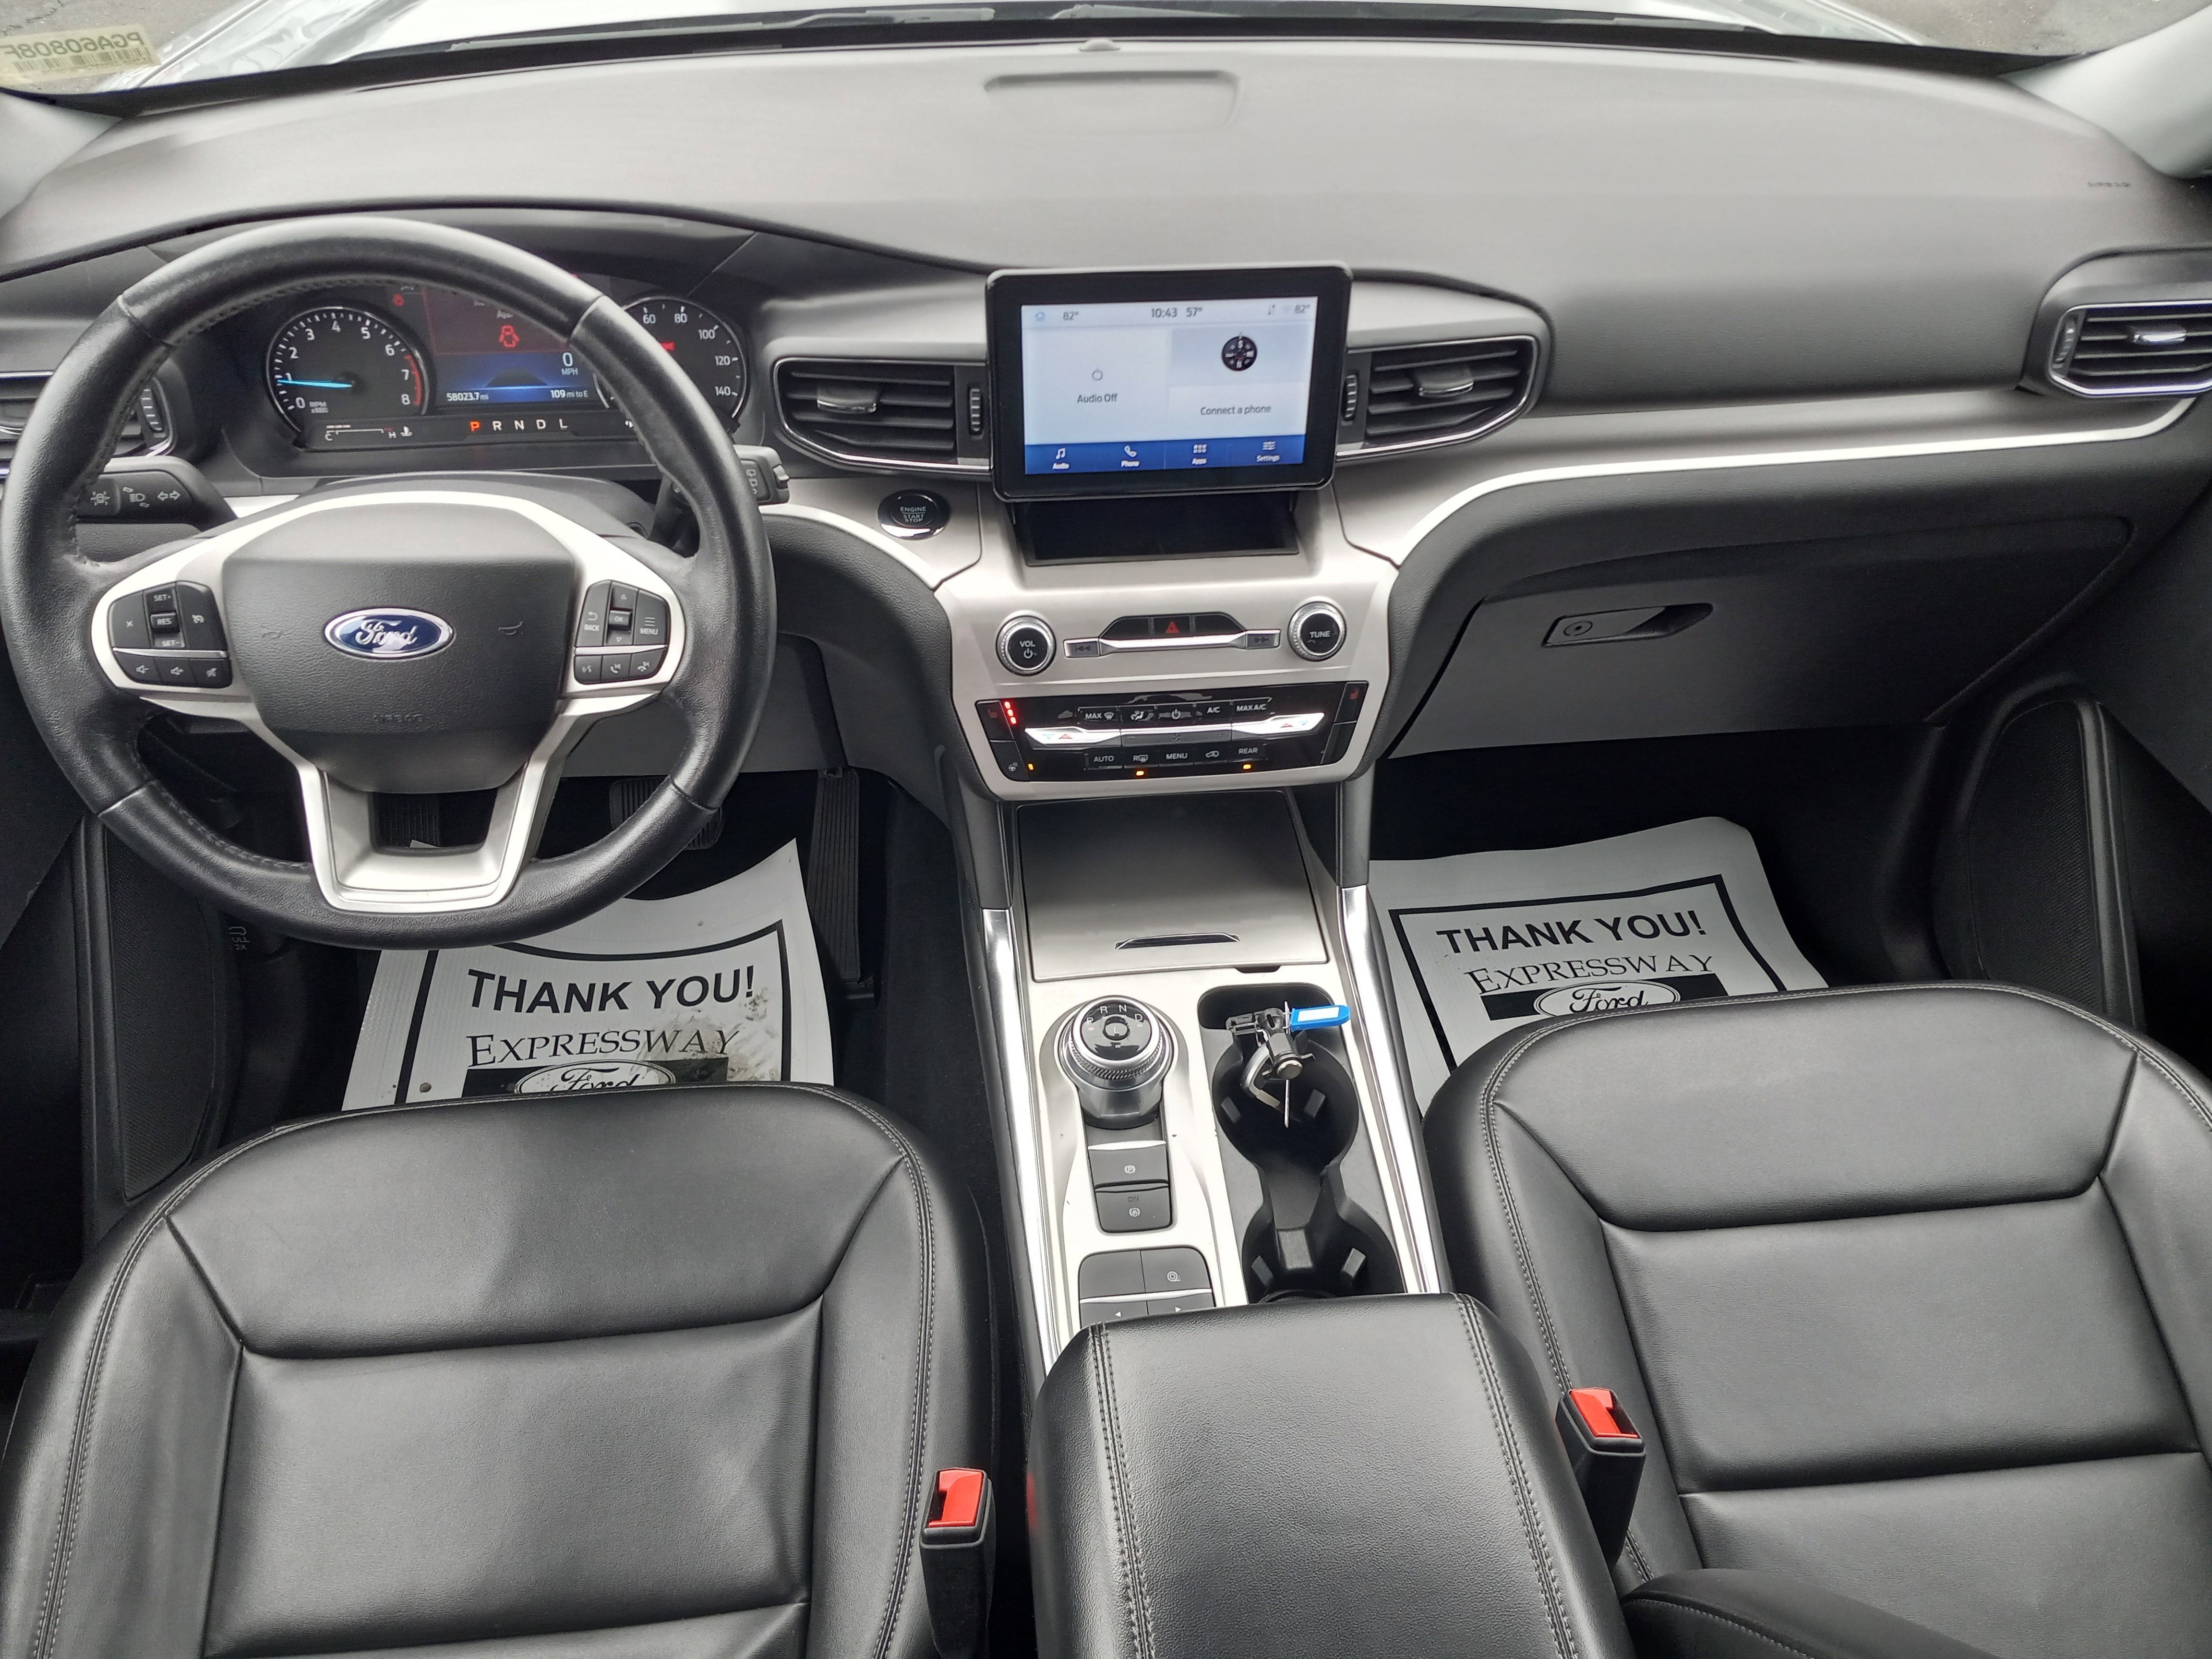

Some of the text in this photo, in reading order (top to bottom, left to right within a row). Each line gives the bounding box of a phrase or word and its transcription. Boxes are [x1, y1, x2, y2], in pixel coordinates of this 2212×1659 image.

[643, 314, 656, 324] 60
[674, 313, 687, 324] 80
[1152, 308, 1177, 319] 10:43
[332, 320, 341, 332] 4
[305, 329, 315, 341] 3
[361, 327, 371, 339] 5
[698, 329, 715, 339] 100
[290, 347, 299, 359] 2
[385, 344, 395, 356] 6
[562, 352, 573, 367] 0
[715, 356, 731, 366] 120
[401, 369, 409, 381] 7
[446, 392, 480, 401] 58023.7
[551, 390, 565, 398] 109
[715, 386, 731, 397] 140
[295, 397, 305, 409] 0
[401, 393, 411, 405] 8
[1077, 393, 1118, 403] Audio Off
[1201, 406, 1235, 416] Connect
[1244, 405, 1272, 415] phone
[470, 419, 568, 431] P R N D L
[355, 619, 419, 646] Ford
[1309, 630, 1331, 638] TUNE
[1436, 911, 1707, 954] THANK YOU!
[468, 964, 754, 1014] THANK YOU!
[1119, 1004, 1127, 1012] N
[1134, 1014, 1142, 1022] D
